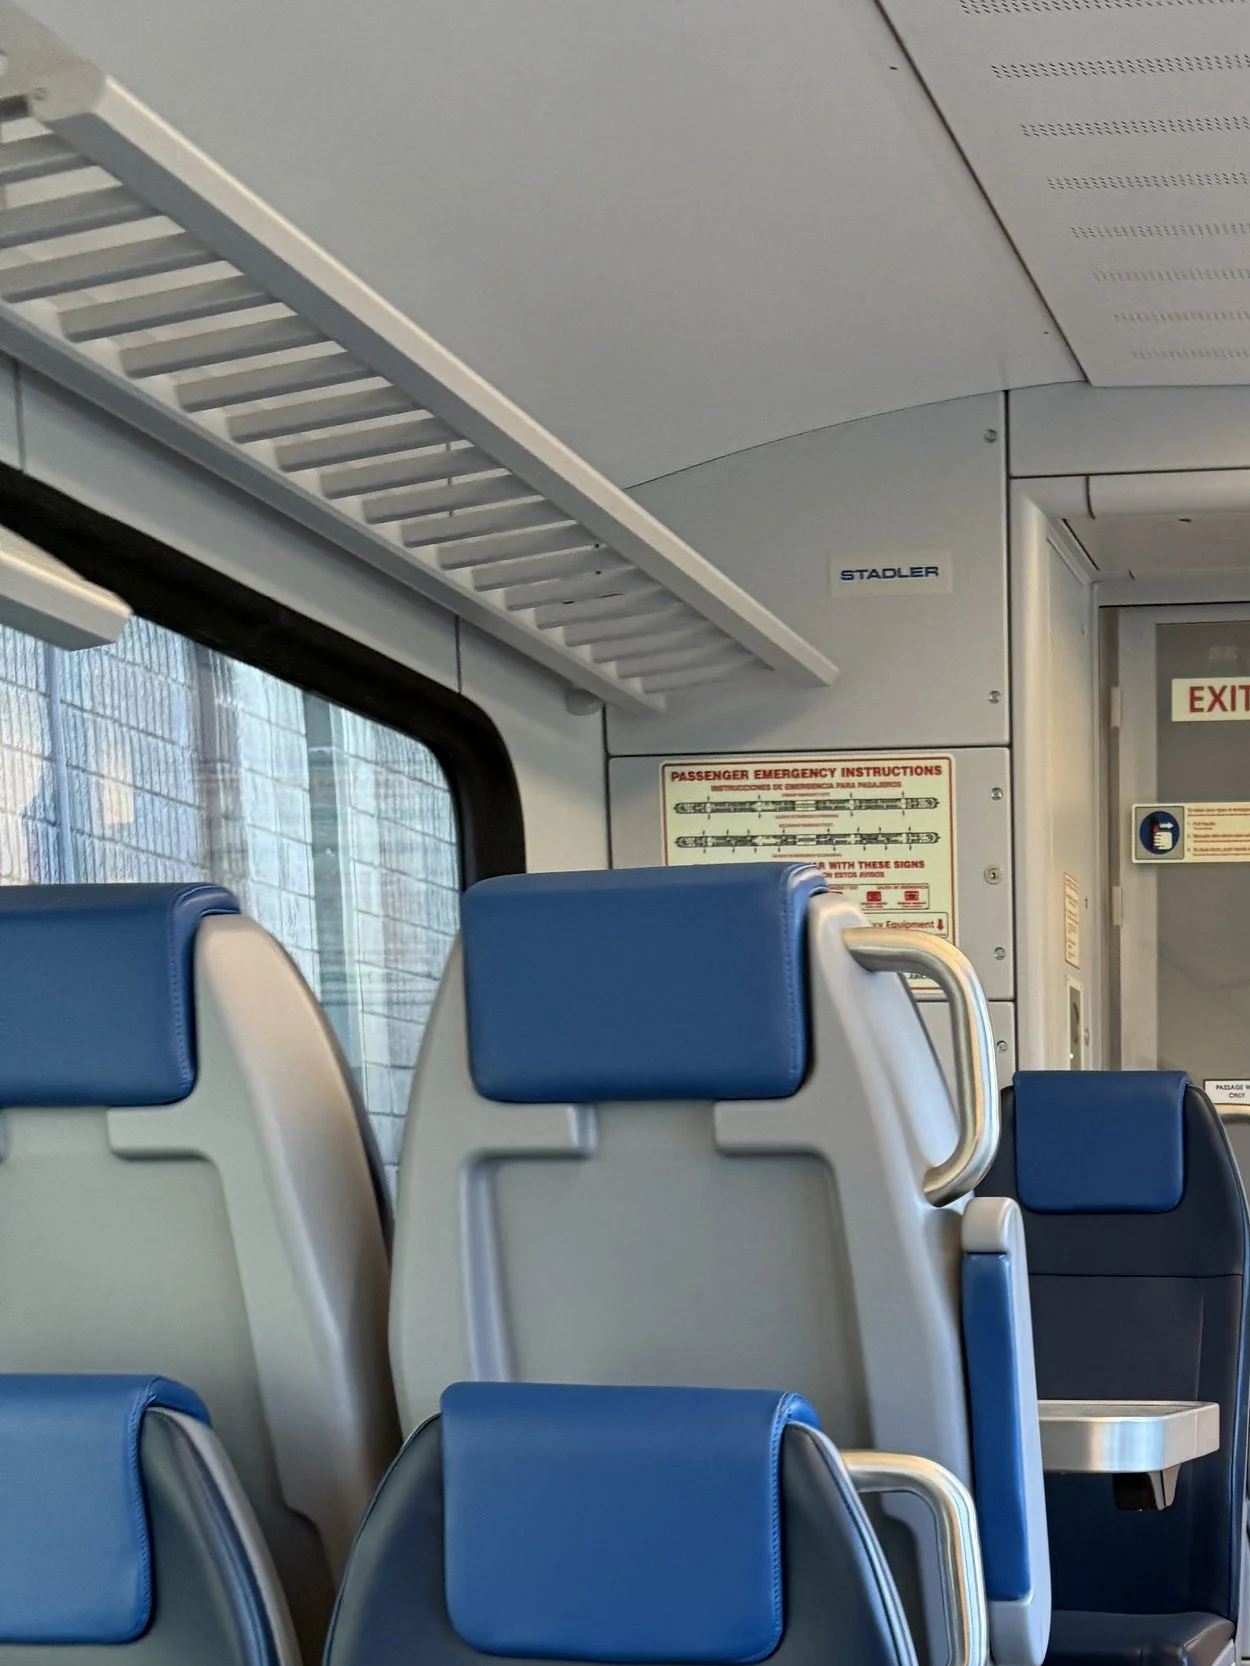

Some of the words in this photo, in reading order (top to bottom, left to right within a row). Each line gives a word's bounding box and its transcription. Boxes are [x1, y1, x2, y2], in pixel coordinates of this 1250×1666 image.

[840, 566, 939, 580] STADLER
[671, 770, 749, 782] PASSENGER
[754, 767, 837, 780] EMERGENCY
[841, 765, 943, 778] INSTRUCTIONS
[829, 861, 856, 870] WITH
[858, 861, 891, 870] THESE
[894, 860, 925, 869] SIGNS
